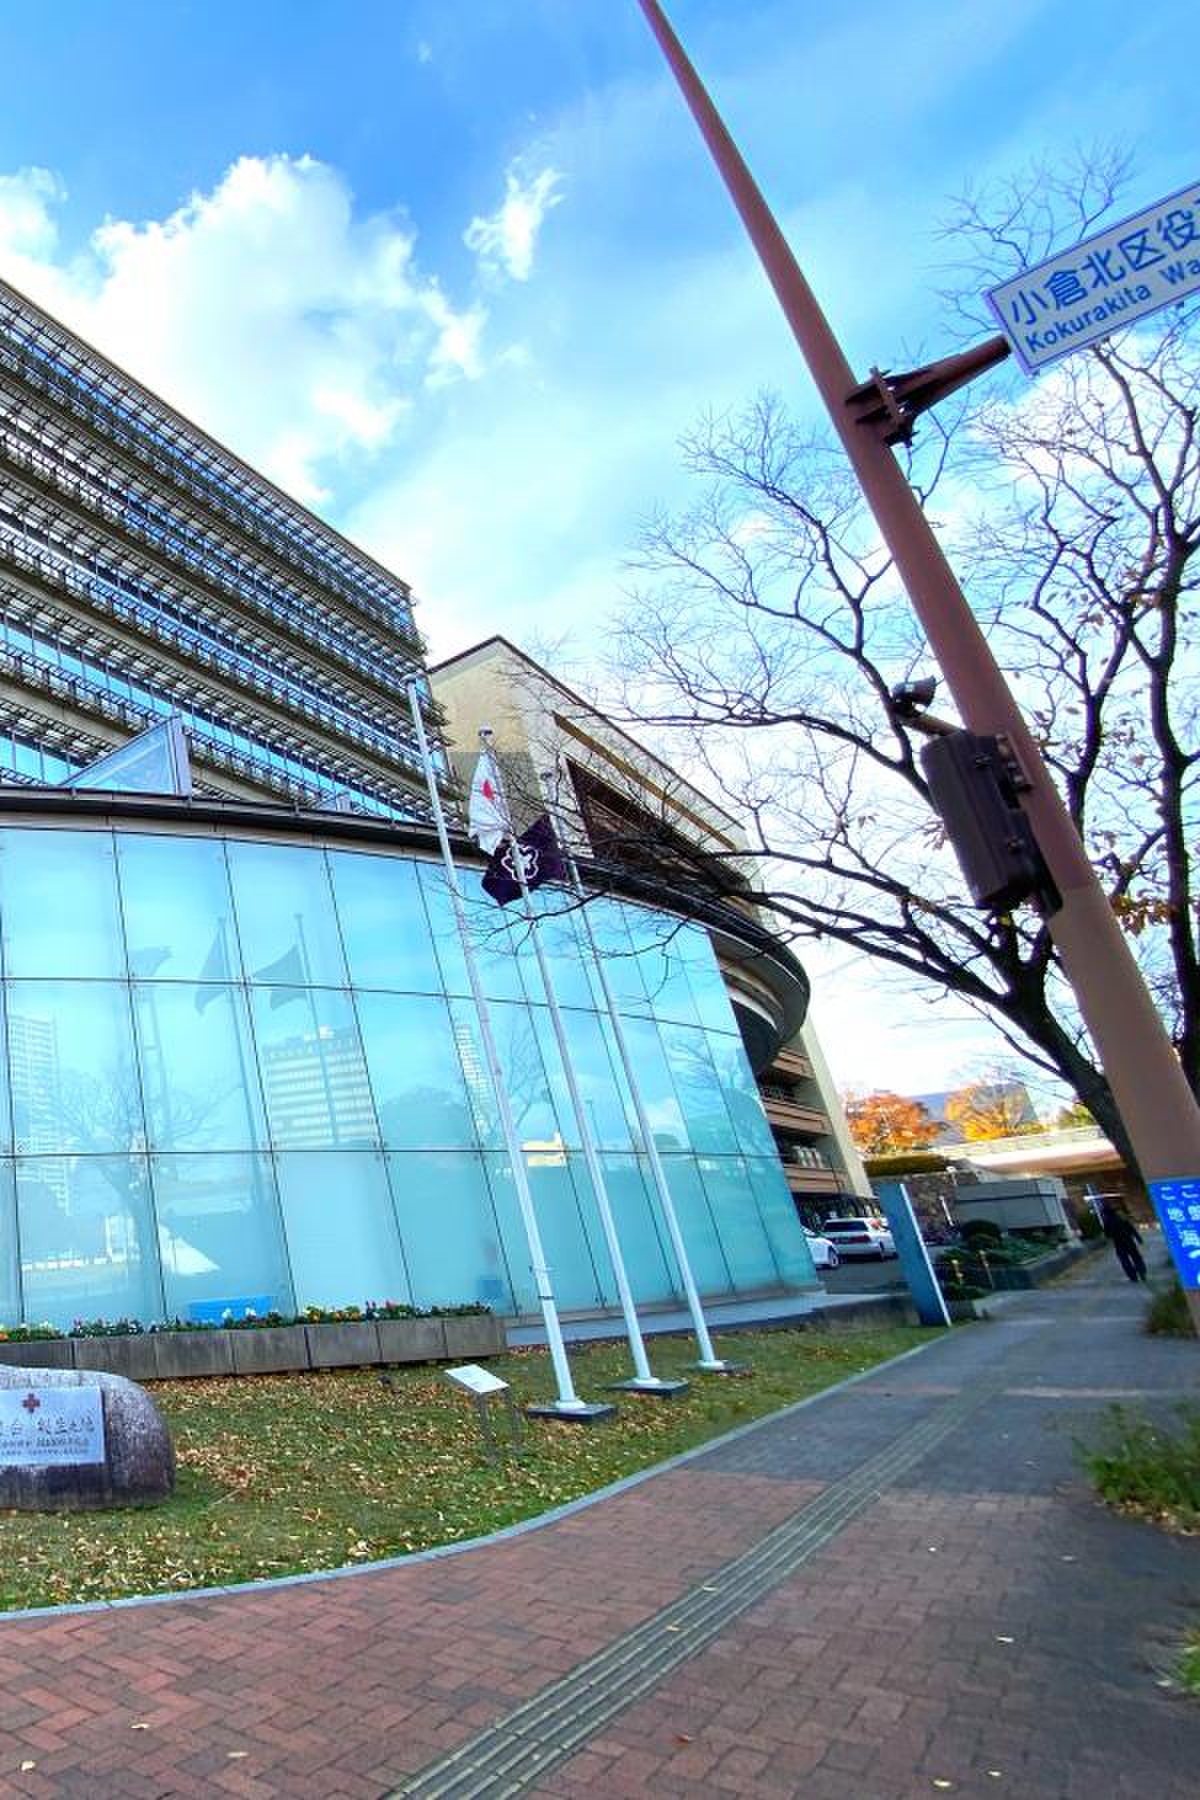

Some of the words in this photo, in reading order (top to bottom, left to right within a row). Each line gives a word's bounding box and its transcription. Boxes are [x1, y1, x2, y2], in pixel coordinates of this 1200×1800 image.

[1011, 200, 1200, 325] 小倉北区役
[1025, 284, 1151, 351] Kokurakita
